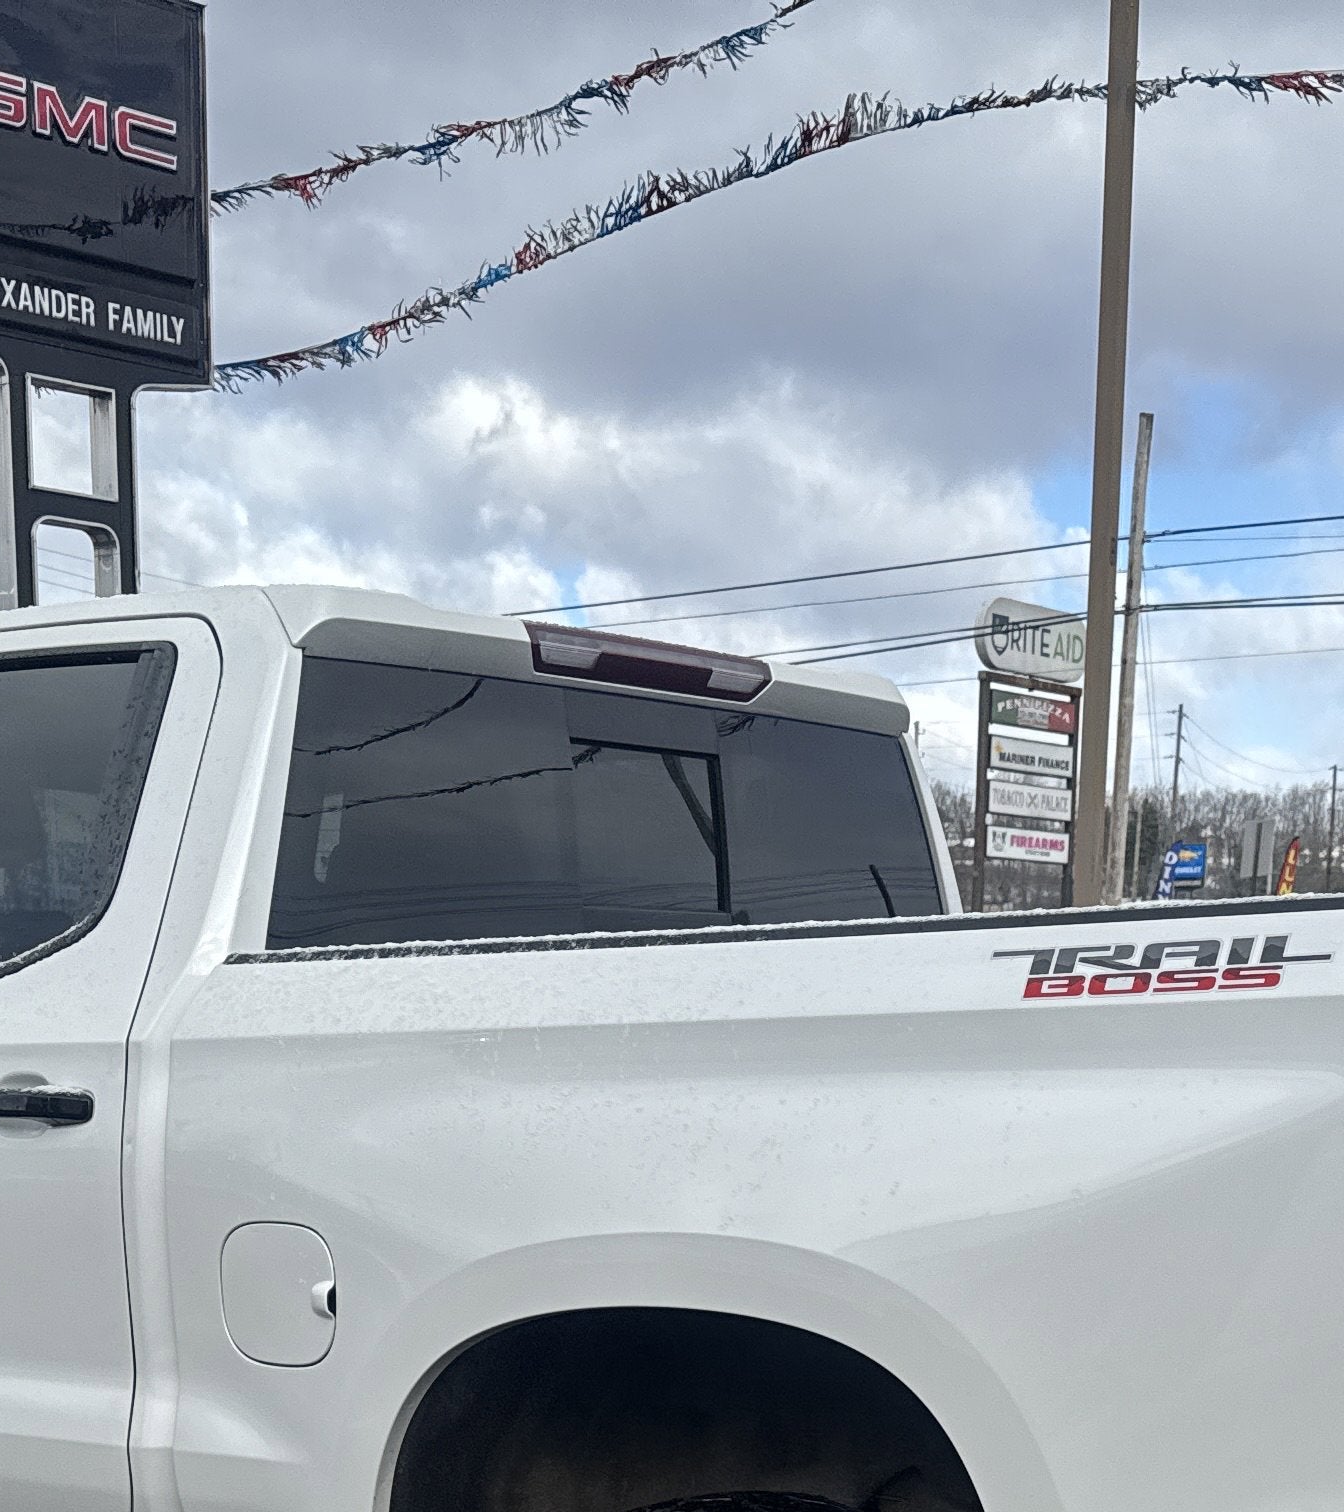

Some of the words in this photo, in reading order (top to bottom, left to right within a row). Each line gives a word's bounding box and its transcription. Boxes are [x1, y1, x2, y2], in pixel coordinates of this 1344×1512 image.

[108, 302, 185, 345] FAMILY
[1010, 623, 1051, 658] RITE
[1053, 631, 1084, 664] AID
[999, 752, 1036, 767] MARINER
[1038, 756, 1070, 771] FINANCE
[1010, 834, 1065, 852] FIREARMS
[992, 934, 1334, 975] TRAIL
[1022, 965, 1284, 999] BOSS
